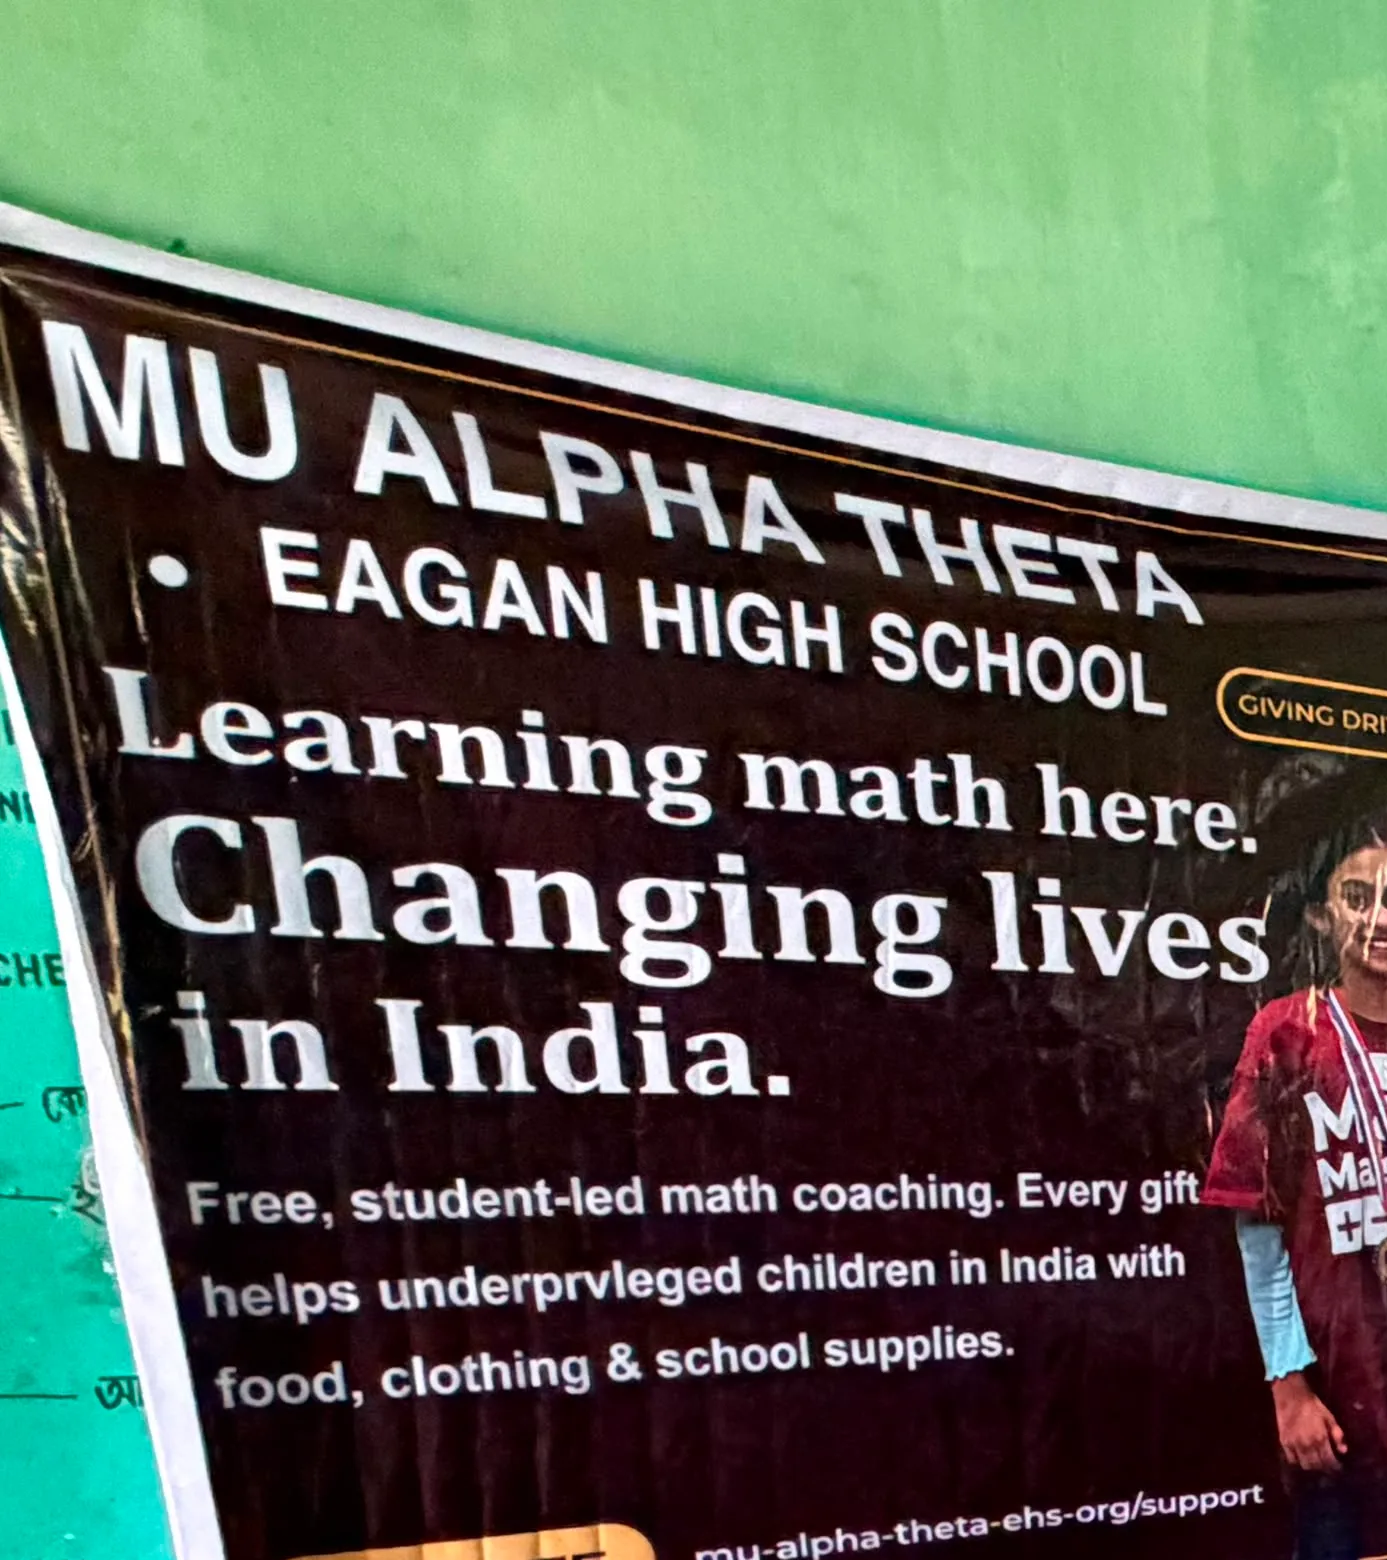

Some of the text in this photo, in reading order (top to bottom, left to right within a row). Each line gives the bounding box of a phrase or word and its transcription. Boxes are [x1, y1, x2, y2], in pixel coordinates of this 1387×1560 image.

[41, 319, 1204, 626] MU ALPHA THETA
[259, 525, 1167, 717] EAGAN HIGH SCHOOL
[1238, 693, 1335, 727] GIVING
[102, 666, 713, 827] Learning
[738, 752, 1013, 832] math
[1035, 762, 1258, 854] here.
[135, 813, 1270, 999] Changing lives
[0, 951, 67, 988] CHE
[171, 990, 791, 1096] in India.
[186, 1169, 1200, 1230] Free, student-led math coaching. Every gift
[202, 1243, 1186, 1324] helps underprvleged children in India with
[215, 1325, 1014, 1409] food, clothing & school supplies.
